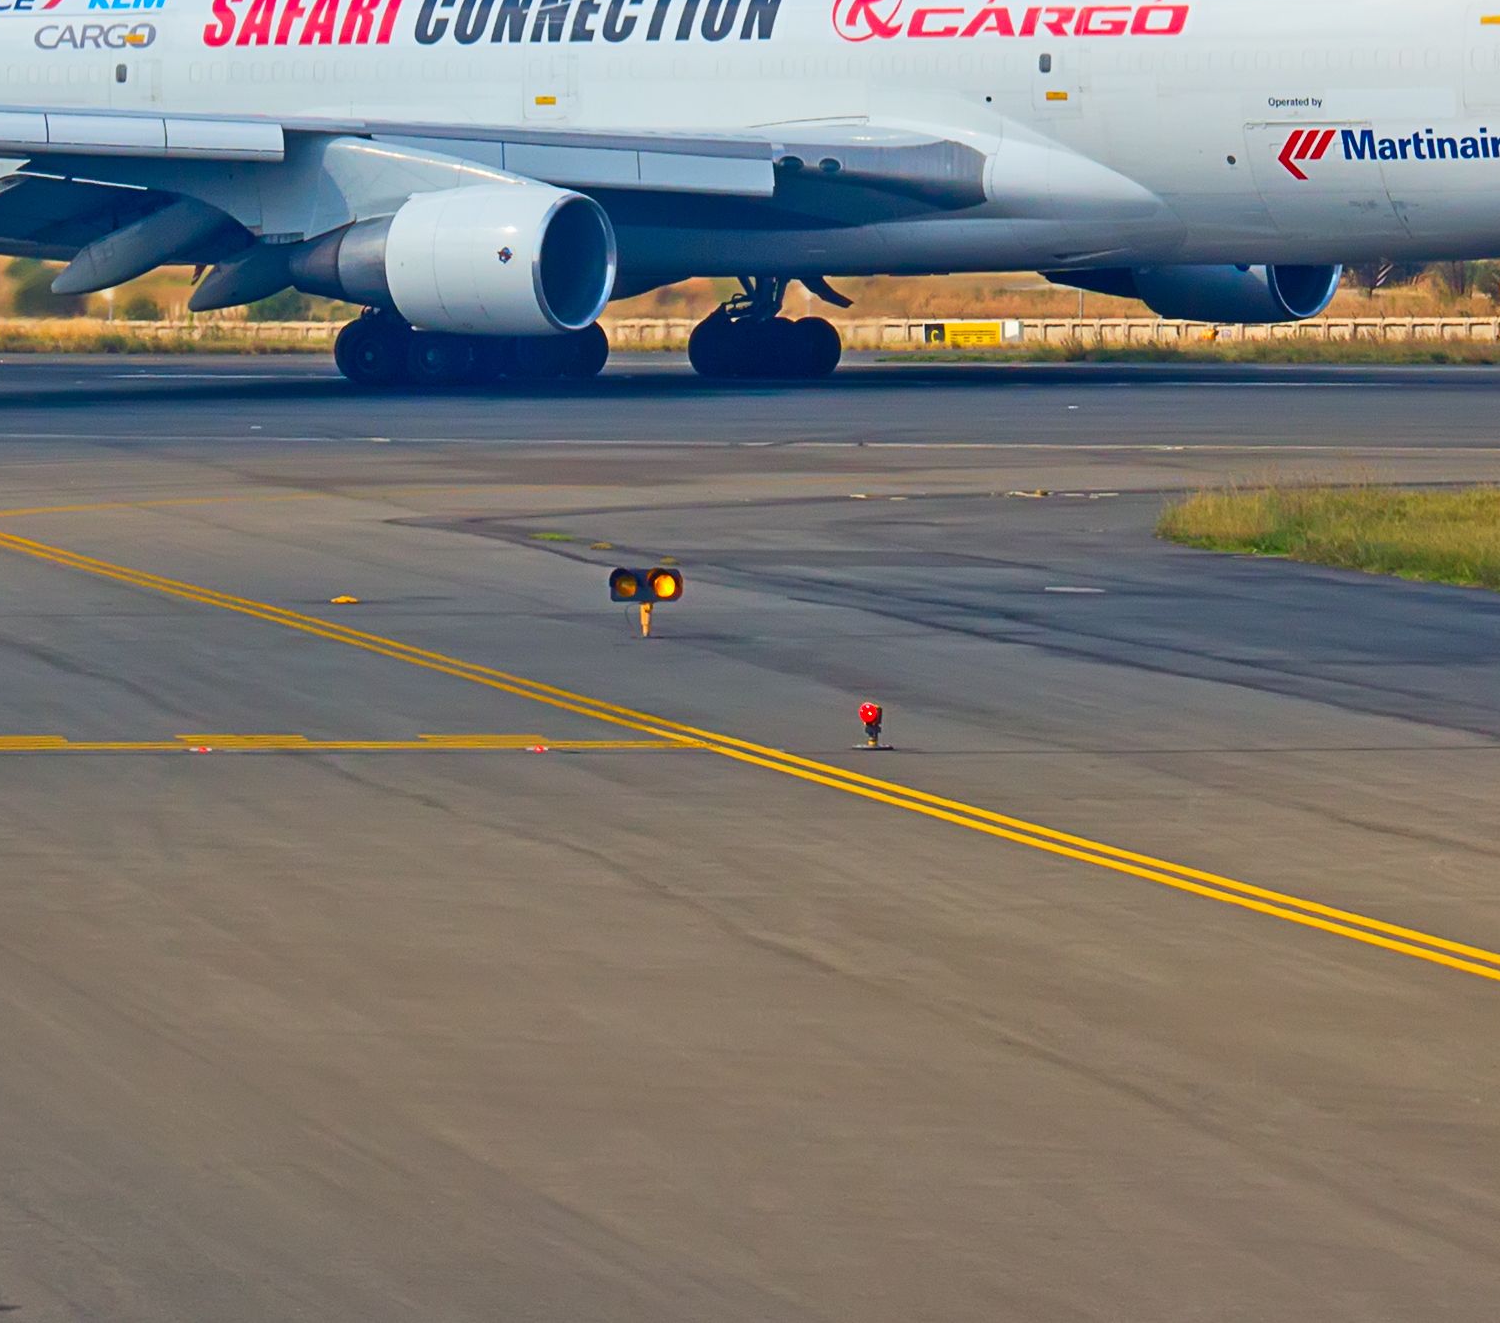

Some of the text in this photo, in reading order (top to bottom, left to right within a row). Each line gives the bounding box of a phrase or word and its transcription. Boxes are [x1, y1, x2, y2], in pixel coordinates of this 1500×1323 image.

[907, 5, 1189, 38] CARGO
[34, 23, 157, 50] CARGO
[1267, 97, 1323, 108] Operated by
